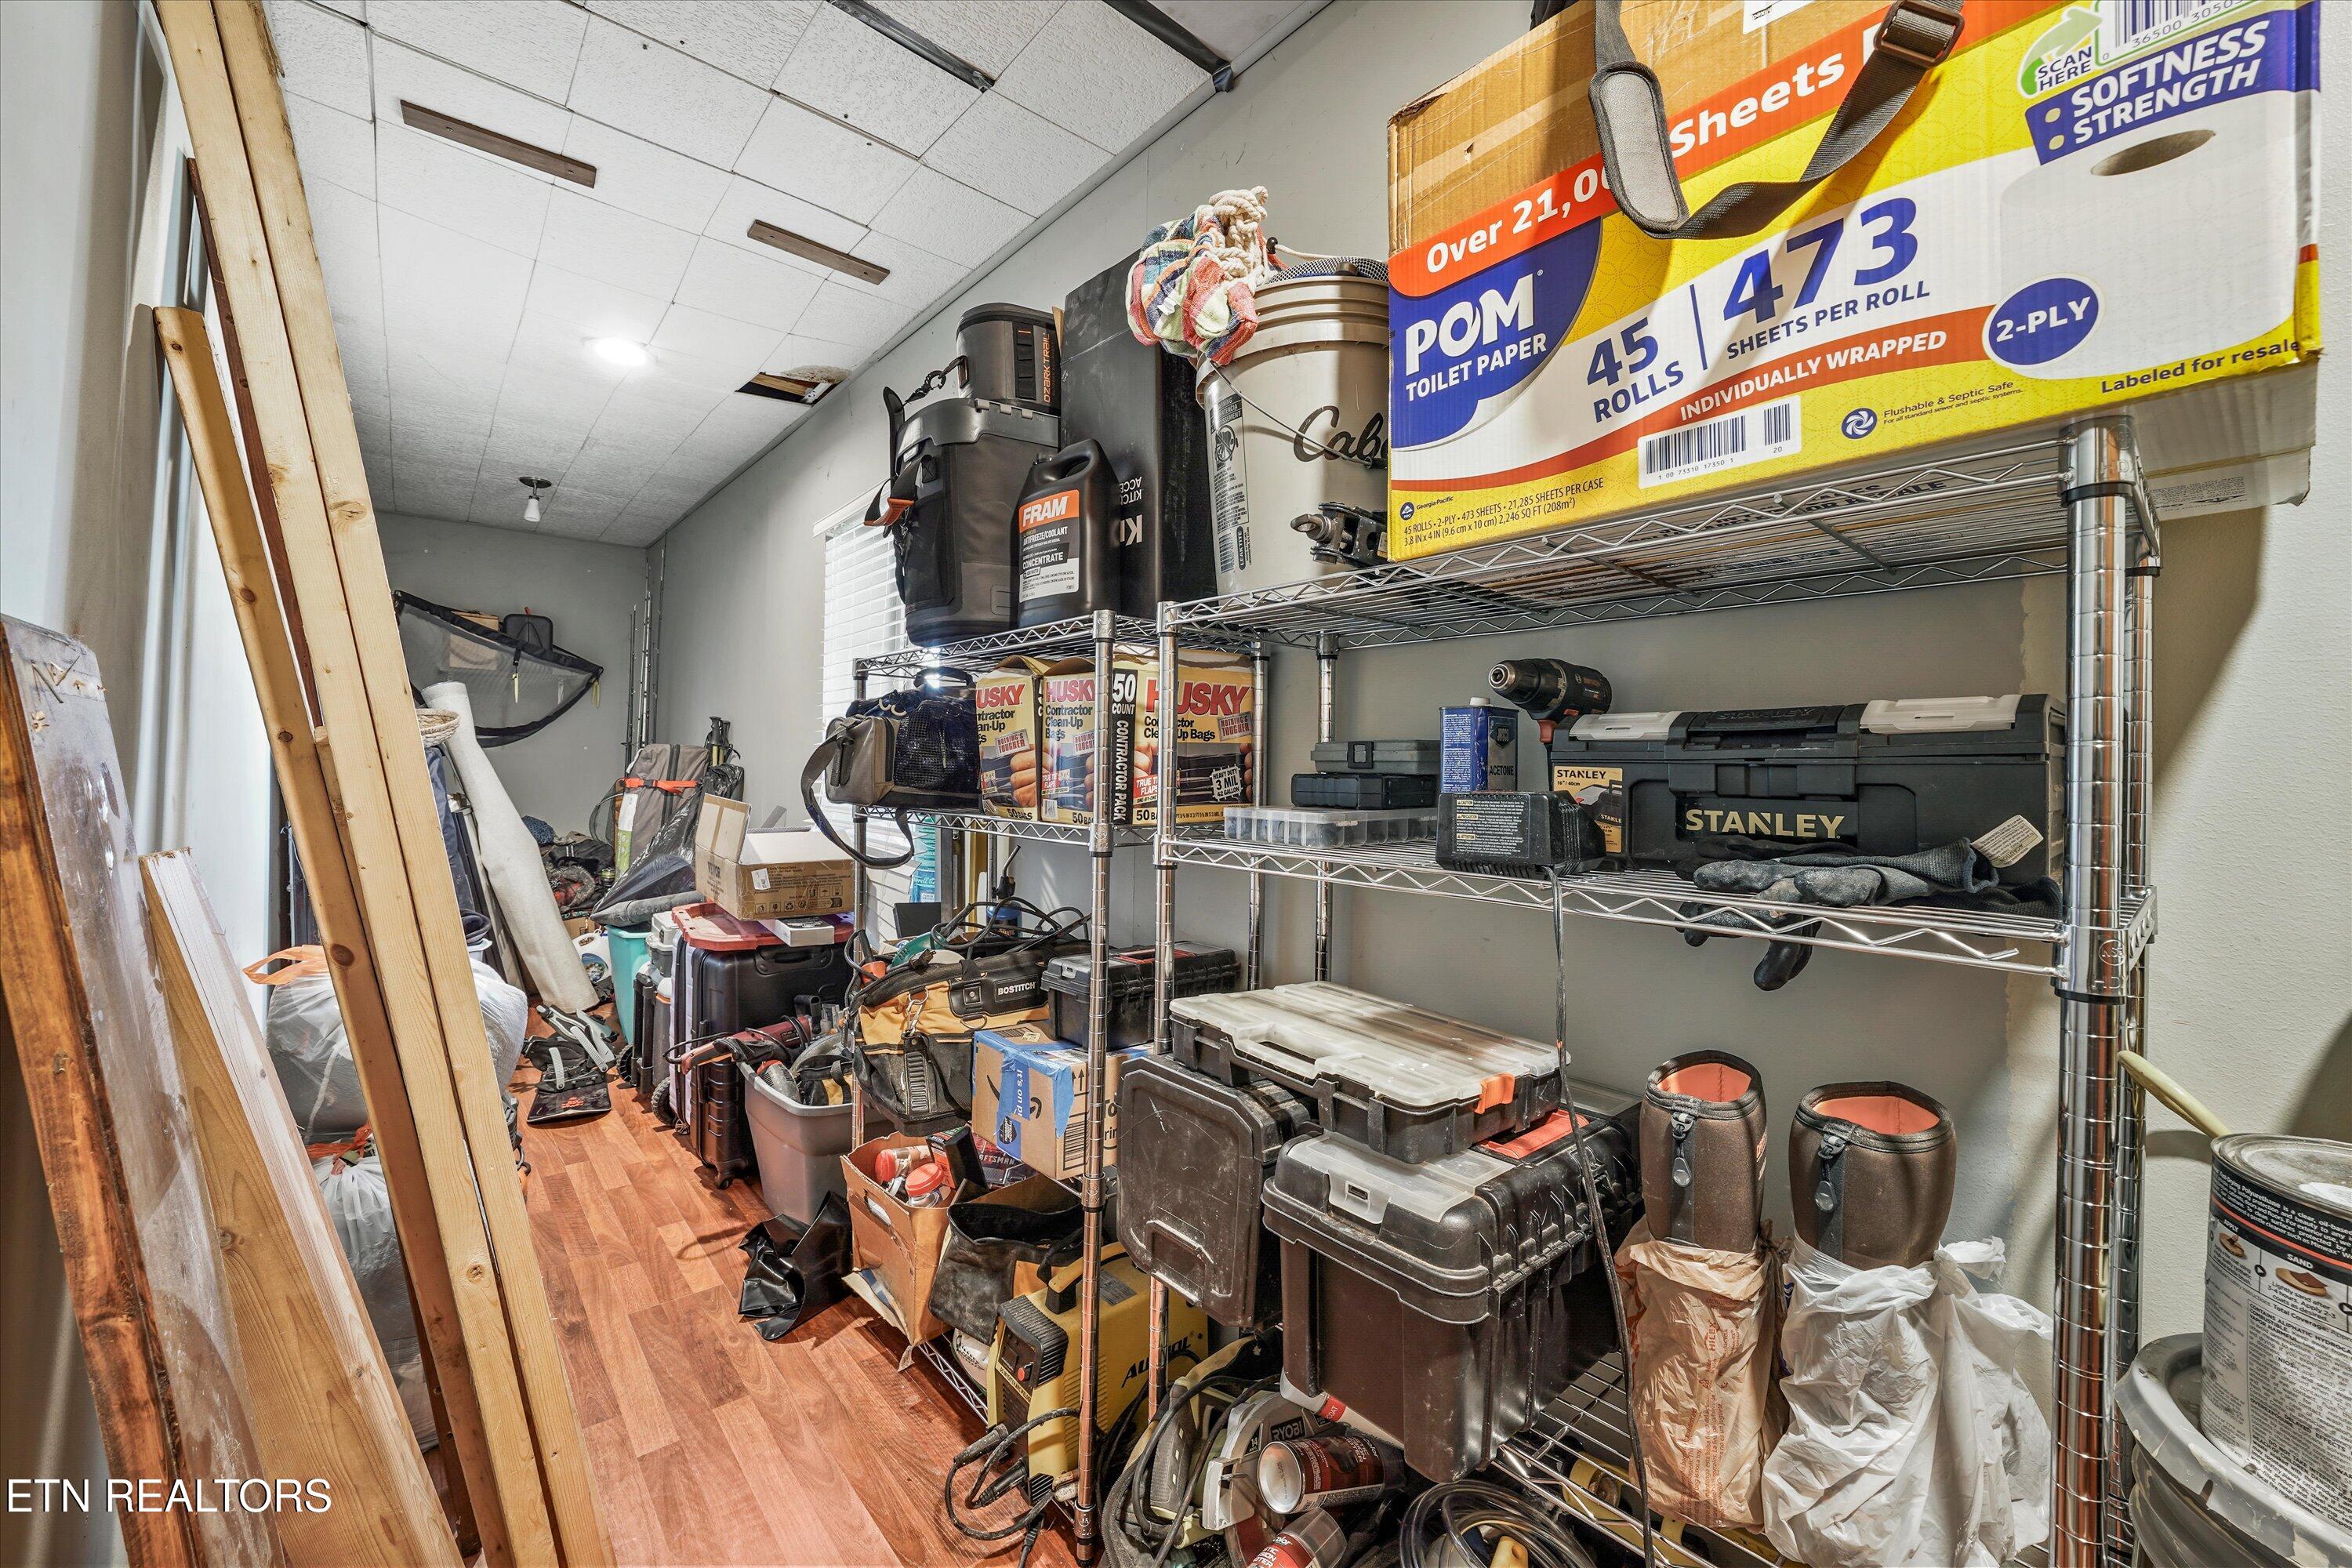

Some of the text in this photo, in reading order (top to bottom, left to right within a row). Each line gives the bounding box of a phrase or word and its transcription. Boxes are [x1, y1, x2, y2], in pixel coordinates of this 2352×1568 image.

[2132, 20, 2182, 48] 36500
[2192, 0, 2242, 22] 3050
[2038, 46, 2092, 77] SCAN
[2039, 60, 2091, 91] HERE
[2071, 20, 2270, 118] SOFTNESS
[2073, 59, 2261, 144] STRENGTH
[1427, 218, 1503, 273] Over
[1670, 49, 1846, 159] Sheets
[1723, 198, 1918, 324] 473
[1406, 274, 1534, 376] POM
[1726, 280, 1930, 360] SHEETS PER ROLL
[1996, 296, 2091, 343] 2-PLY
[1588, 317, 1659, 386] 45
[1406, 333, 1547, 401] TOILET PAPER
[1680, 330, 1947, 421] INDIVIDUALLY WRAPPED
[2101, 339, 2301, 393] Labeled for resale
[1593, 361, 1685, 423] ROLLS
[1884, 380, 2014, 418] Flushable & Septic Safe
[1904, 409, 1933, 421] standard
[1934, 405, 1954, 414] sewer
[1969, 395, 1991, 406] septic
[1993, 388, 2024, 401] systems.
[1773, 445, 1783, 454] 20
[1678, 466, 1699, 476] 73310
[1704, 459, 1725, 470] 17350
[1022, 496, 1069, 528] FRAM
[1404, 477, 1604, 535] 45 ROLLS 2-PLY 473 SHEETS 21,285 SHEETS PER CASE
[1023, 526, 1068, 546] ANTIFREEZE/COOLANT
[1404, 536, 1414, 546] 3.8
[1415, 535, 1422, 544] IN
[1433, 530, 1441, 539] IN
[1442, 527, 1455, 539] (9.6
[1475, 521, 1483, 530] 10
[1483, 517, 1497, 528] cm)
[1499, 511, 1519, 525] 2,246
[1521, 508, 1532, 519] SQ
[1533, 506, 1541, 516] FT
[1022, 551, 1064, 570] CONCENTRATE
[976, 684, 1025, 709] USKY
[1112, 673, 1136, 702] 50
[1045, 706, 1093, 716] Contractor
[1045, 716, 1083, 728] Clean-Up
[1112, 703, 1135, 715] COUNT
[1045, 728, 1065, 741] Bags
[1191, 728, 1215, 742] Bags
[1221, 723, 1250, 737] TOUGHER
[998, 739, 1025, 753] TOUGHER
[1113, 720, 1129, 821] CONTRACTOR PACK
[1136, 779, 1152, 788] TRUE
[1216, 775, 1239, 789] 3 MIL
[1490, 765, 1514, 775] ACETONE
[1557, 769, 1606, 779] STANLEY
[1225, 786, 1240, 795] GALLON
[1007, 808, 1033, 820] 50 BAGS
[1073, 812, 1083, 823] 50
[1136, 810, 1150, 821] 50
[1686, 809, 1845, 839] STANLEY
[998, 982, 1035, 995] BOSTITCH
[1018, 1089, 1023, 1103] on
[2241, 1185, 2316, 1224] Polyurethane clear,
[2252, 1198, 2318, 1230] protection beauty
[2223, 1219, 2239, 1232] APPLY
[2271, 1217, 2332, 1247] surfaces protected
[2297, 1224, 2322, 1237] exterior
[2287, 1254, 2314, 1269] SAND
[2272, 1281, 2330, 1310] Lightly sand after
[2273, 1294, 2328, 1322] coats desired.
[2278, 1290, 2321, 1314] hours. Apply
[2249, 1303, 2313, 1338] CONTAINS ALIPHATIC
[2274, 1304, 2329, 1333] Total Coverage:
[1250, 1438, 1258, 1446] 14
[1272, 1422, 1305, 1441] RYOBI
[2315, 1432, 2346, 1452] EFFECTS
